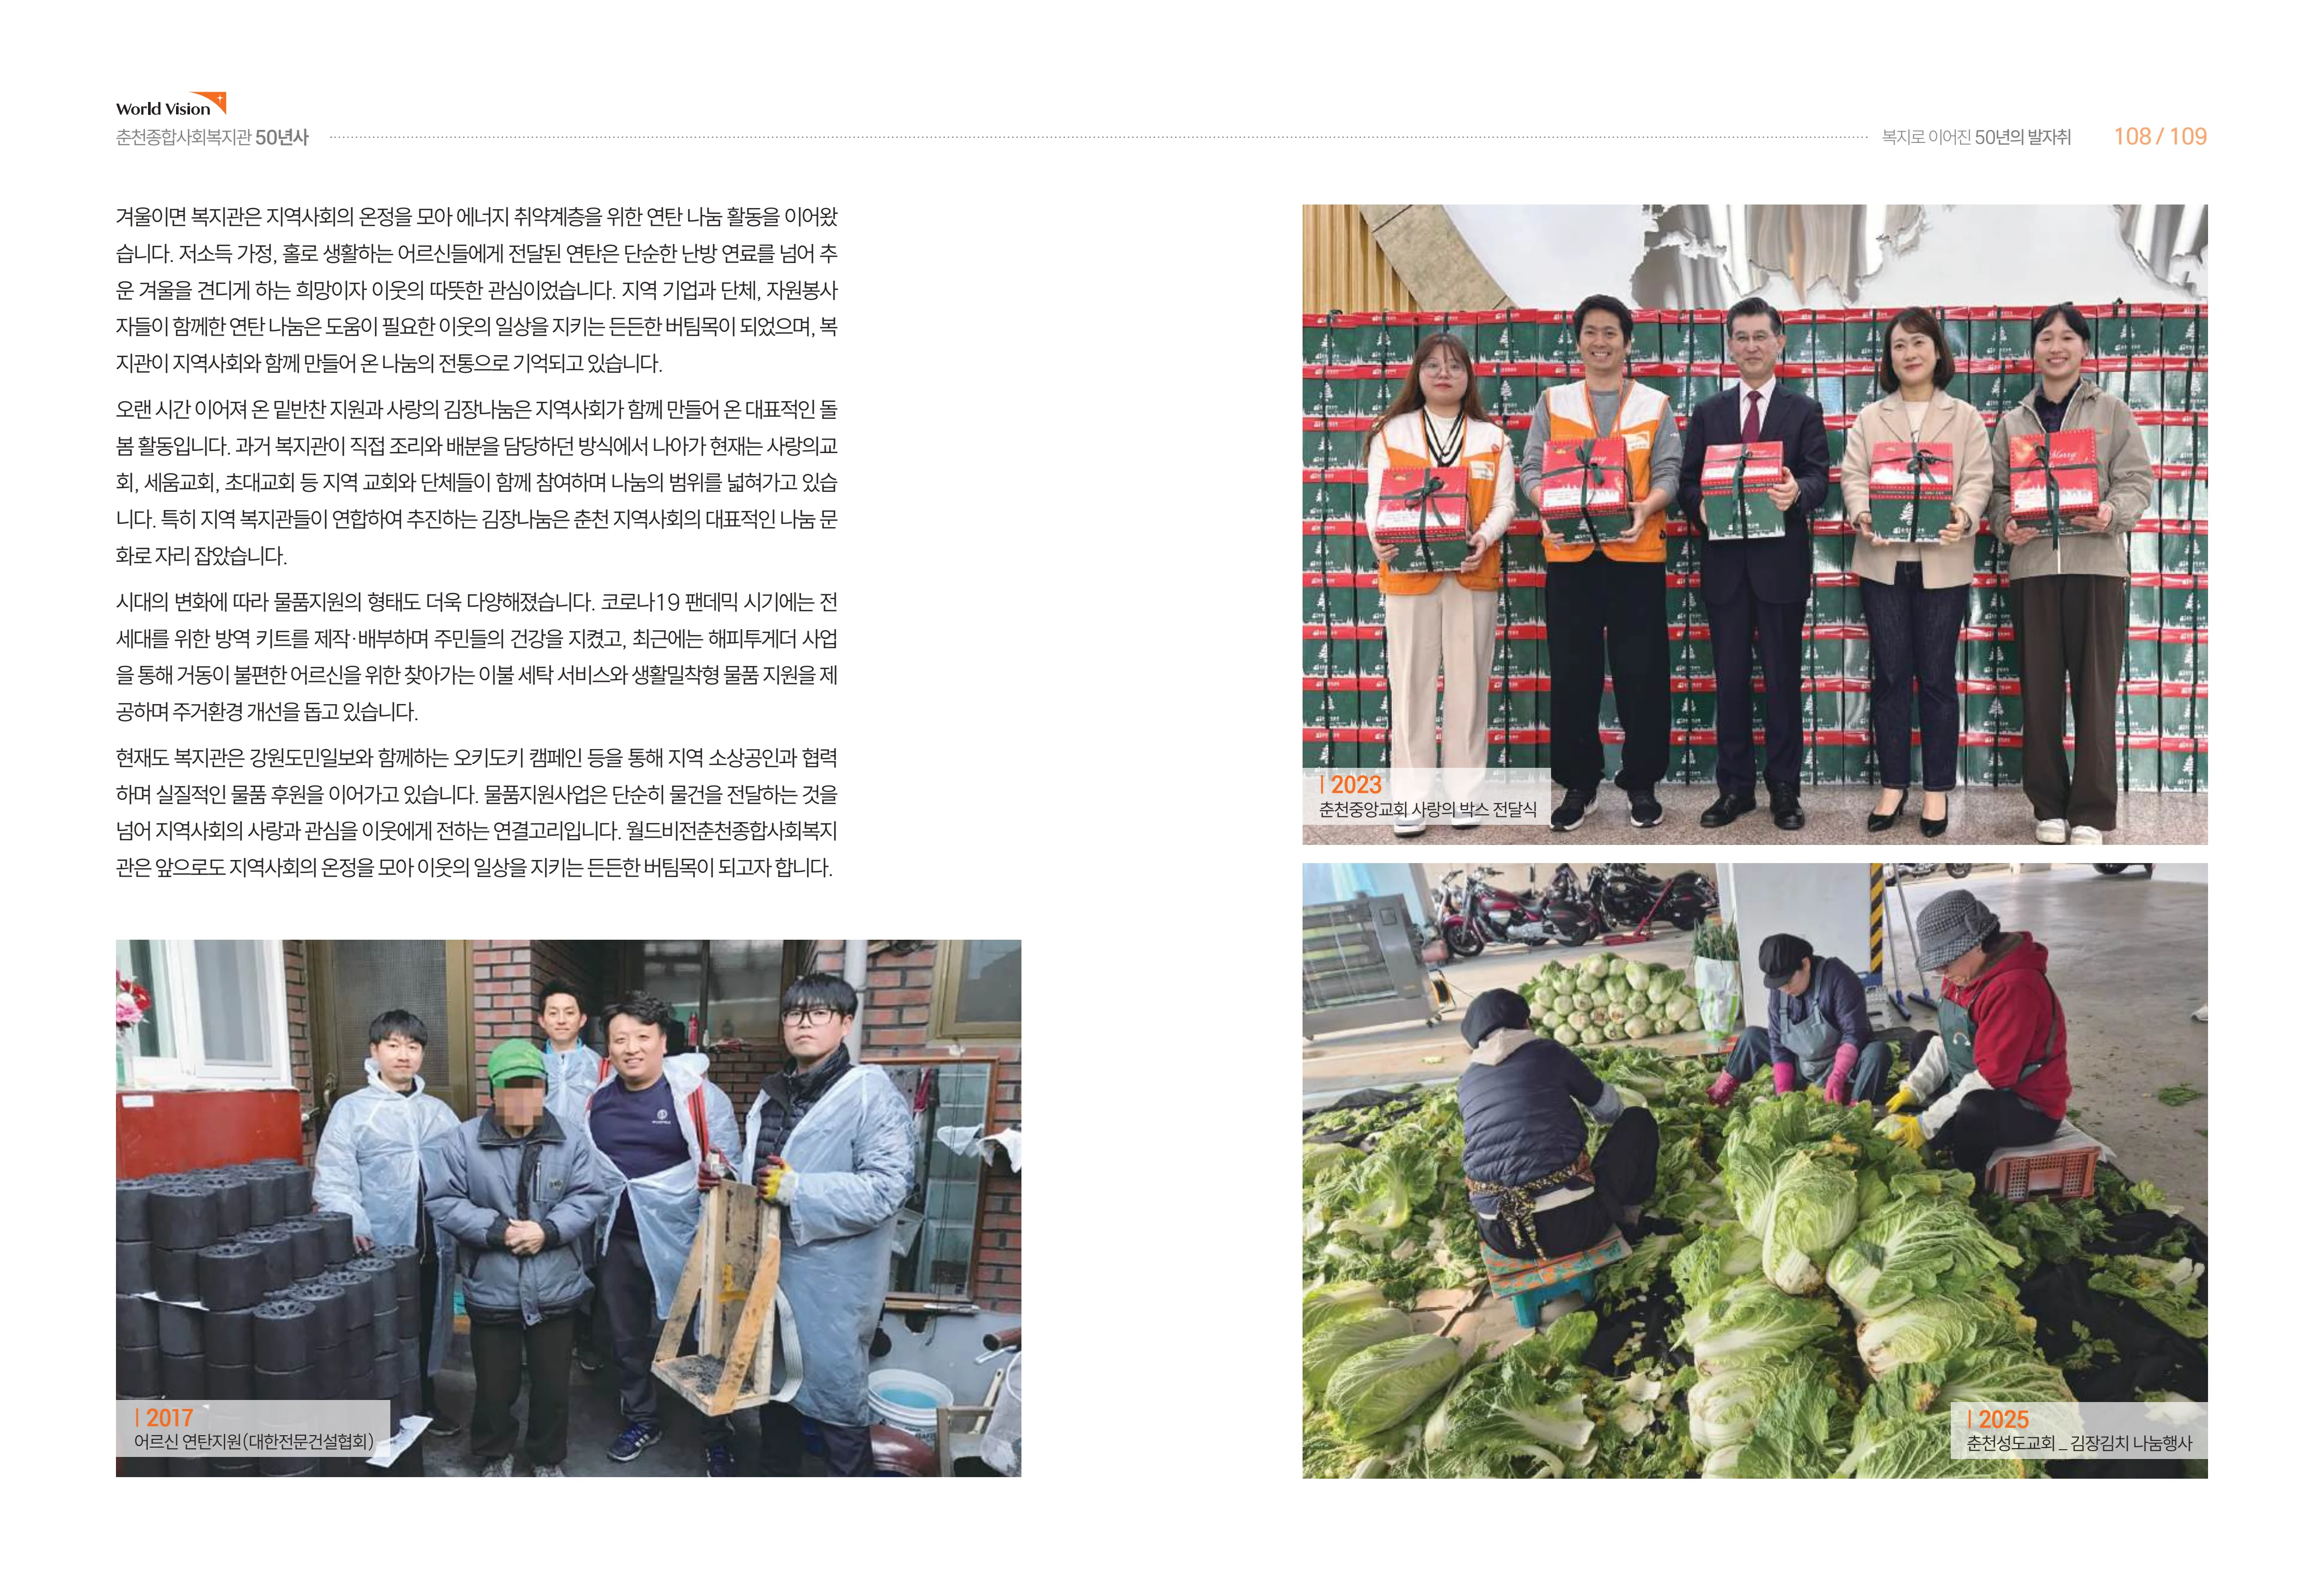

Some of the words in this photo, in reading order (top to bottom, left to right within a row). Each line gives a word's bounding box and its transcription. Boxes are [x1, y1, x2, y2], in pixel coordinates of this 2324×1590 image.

[116, 102, 160, 115] World
[166, 103, 210, 115] Vision
[116, 129, 252, 145] 춘천종합사회복지관
[256, 128, 309, 146] 50년사
[1882, 129, 1925, 145] 복지로
[1929, 129, 1970, 145] 이어진
[1976, 129, 2024, 145] 50년의
[2028, 129, 2070, 145] 발자취
[2115, 127, 2151, 145] 108
[2171, 127, 2207, 145] 109
[116, 207, 185, 227] 겨울이면
[192, 207, 262, 227] 복지관은
[267, 207, 353, 227] 지역사회의
[359, 207, 412, 227] 온정을
[417, 207, 452, 227] 모아
[457, 207, 508, 227] 에너지
[515, 207, 602, 227] 취약계층을
[607, 207, 642, 227] 위한
[648, 207, 683, 226] 연탄
[688, 207, 722, 227] 나눔
[727, 207, 780, 227] 활동을
[785, 207, 838, 227] 이어왔
[116, 281, 134, 300] 운
[140, 281, 192, 300] 겨울을
[198, 281, 249, 300] 견디게
[256, 281, 291, 300] 하는
[297, 281, 367, 300] 희망이자
[373, 281, 423, 300] 이웃의
[431, 281, 483, 300] 따뜻한
[489, 281, 615, 300] 관심이었습니다.
[623, 281, 656, 300] 지역
[663, 281, 716, 300] 기업과
[722, 281, 760, 301] 단체,
[767, 281, 838, 300] 자원봉사
[116, 354, 167, 373] 지관이
[173, 354, 261, 373] 지역사회와
[265, 354, 299, 373] 함께
[305, 354, 355, 373] 만들어
[361, 354, 378, 373] 온
[383, 354, 433, 373] 나눔의
[440, 354, 509, 373] 전통으로
[514, 354, 583, 373] 기억되고
[588, 354, 662, 373] 있습니다.
[116, 437, 134, 456] 봄
[138, 436, 230, 456] 활동입니다.
[236, 436, 269, 456] 과거
[275, 436, 344, 456] 복지관이
[350, 436, 384, 456] 직접
[390, 436, 443, 456] 조리와
[447, 436, 500, 456] 배분을
[505, 436, 573, 456] 담당하던
[579, 436, 647, 456] 방식에서
[654, 436, 706, 456] 나아가
[710, 436, 763, 456] 현재는
[767, 436, 838, 456] 사랑의교
[116, 473, 138, 493] 회,
[144, 473, 218, 493] 세움교회,
[225, 473, 294, 492] 초대교회
[301, 474, 318, 492] 등
[324, 473, 357, 492] 지역
[363, 473, 416, 492] 교회와
[422, 473, 489, 492] 단체들이
[496, 473, 530, 492] 함께
[537, 473, 605, 492] 참여하며
[612, 473, 663, 492] 나눔의
[670, 473, 722, 492] 범위를
[728, 473, 797, 492] 넓혀가고
[803, 473, 838, 492] 있습
[118, 509, 155, 529] 니다.
[162, 509, 195, 529] 특히
[201, 509, 234, 529] 지역
[240, 509, 327, 529] 복지관들이
[333, 509, 401, 529] 연합하여
[407, 509, 477, 529] 추진하는
[482, 509, 569, 529] 김장나눔은
[574, 509, 608, 529] 춘천
[614, 509, 699, 529] 지역사회의
[707, 509, 775, 529] 대표적인
[781, 509, 815, 529] 나눔
[820, 510, 838, 529] 문
[116, 592, 167, 612] 시대의
[176, 592, 227, 612] 변화에
[234, 592, 269, 612] 따라
[274, 592, 360, 612] 물품지원의
[368, 592, 420, 612] 형태도
[427, 592, 461, 612] 더욱
[468, 592, 594, 612] 다양해졌습니다.
[602, 592, 679, 612] 코로나19
[685, 592, 737, 612] 팬데믹
[744, 592, 814, 612] 시기에는
[821, 592, 837, 611] 전
[116, 629, 169, 649] 세대를
[174, 629, 210, 649] 위한
[216, 629, 249, 649] 방역
[257, 629, 309, 649] 키트를
[315, 629, 427, 649] 제작·배부하며
[434, 629, 503, 649] 주민들의
[511, 629, 563, 649] 건강을
[569, 629, 625, 650] 지켰고,
[633, 629, 703, 649] 최근에는
[709, 629, 795, 649] 해피투게더
[802, 629, 836, 649] 사업
[116, 748, 169, 768] 현재도
[174, 748, 245, 768] 복지관은
[251, 748, 374, 768] 강원도민일보와
[378, 748, 449, 768] 함께하는
[454, 748, 522, 768] 오키도키
[530, 748, 581, 768] 캠페인
[588, 749, 623, 767] 등을
[628, 748, 662, 768] 통해
[669, 748, 702, 768] 지역
[709, 748, 797, 768] 소상공인과
[802, 748, 836, 768] 협력
[116, 785, 150, 805] 하며
[157, 785, 226, 805] 실질적인
[231, 785, 267, 804] 물품
[271, 785, 324, 805] 후원을
[330, 785, 399, 805] 이어가고
[404, 785, 478, 805] 있습니다.
[485, 785, 607, 805] 물품지원사업은
[613, 785, 663, 805] 단순히
[670, 785, 723, 804] 물건을
[727, 785, 798, 805] 전달하는
[803, 785, 838, 804] 것을
[118, 821, 150, 841] 넘어
[156, 821, 242, 841] 지역사회의
[248, 821, 301, 841] 사랑과
[305, 821, 358, 840] 관심을
[363, 821, 431, 841] 이웃에게
[437, 821, 489, 841] 전하는
[494, 821, 621, 841] 연결고리입니다.
[627, 821, 836, 841] 월드비전춘천종합사회복지
